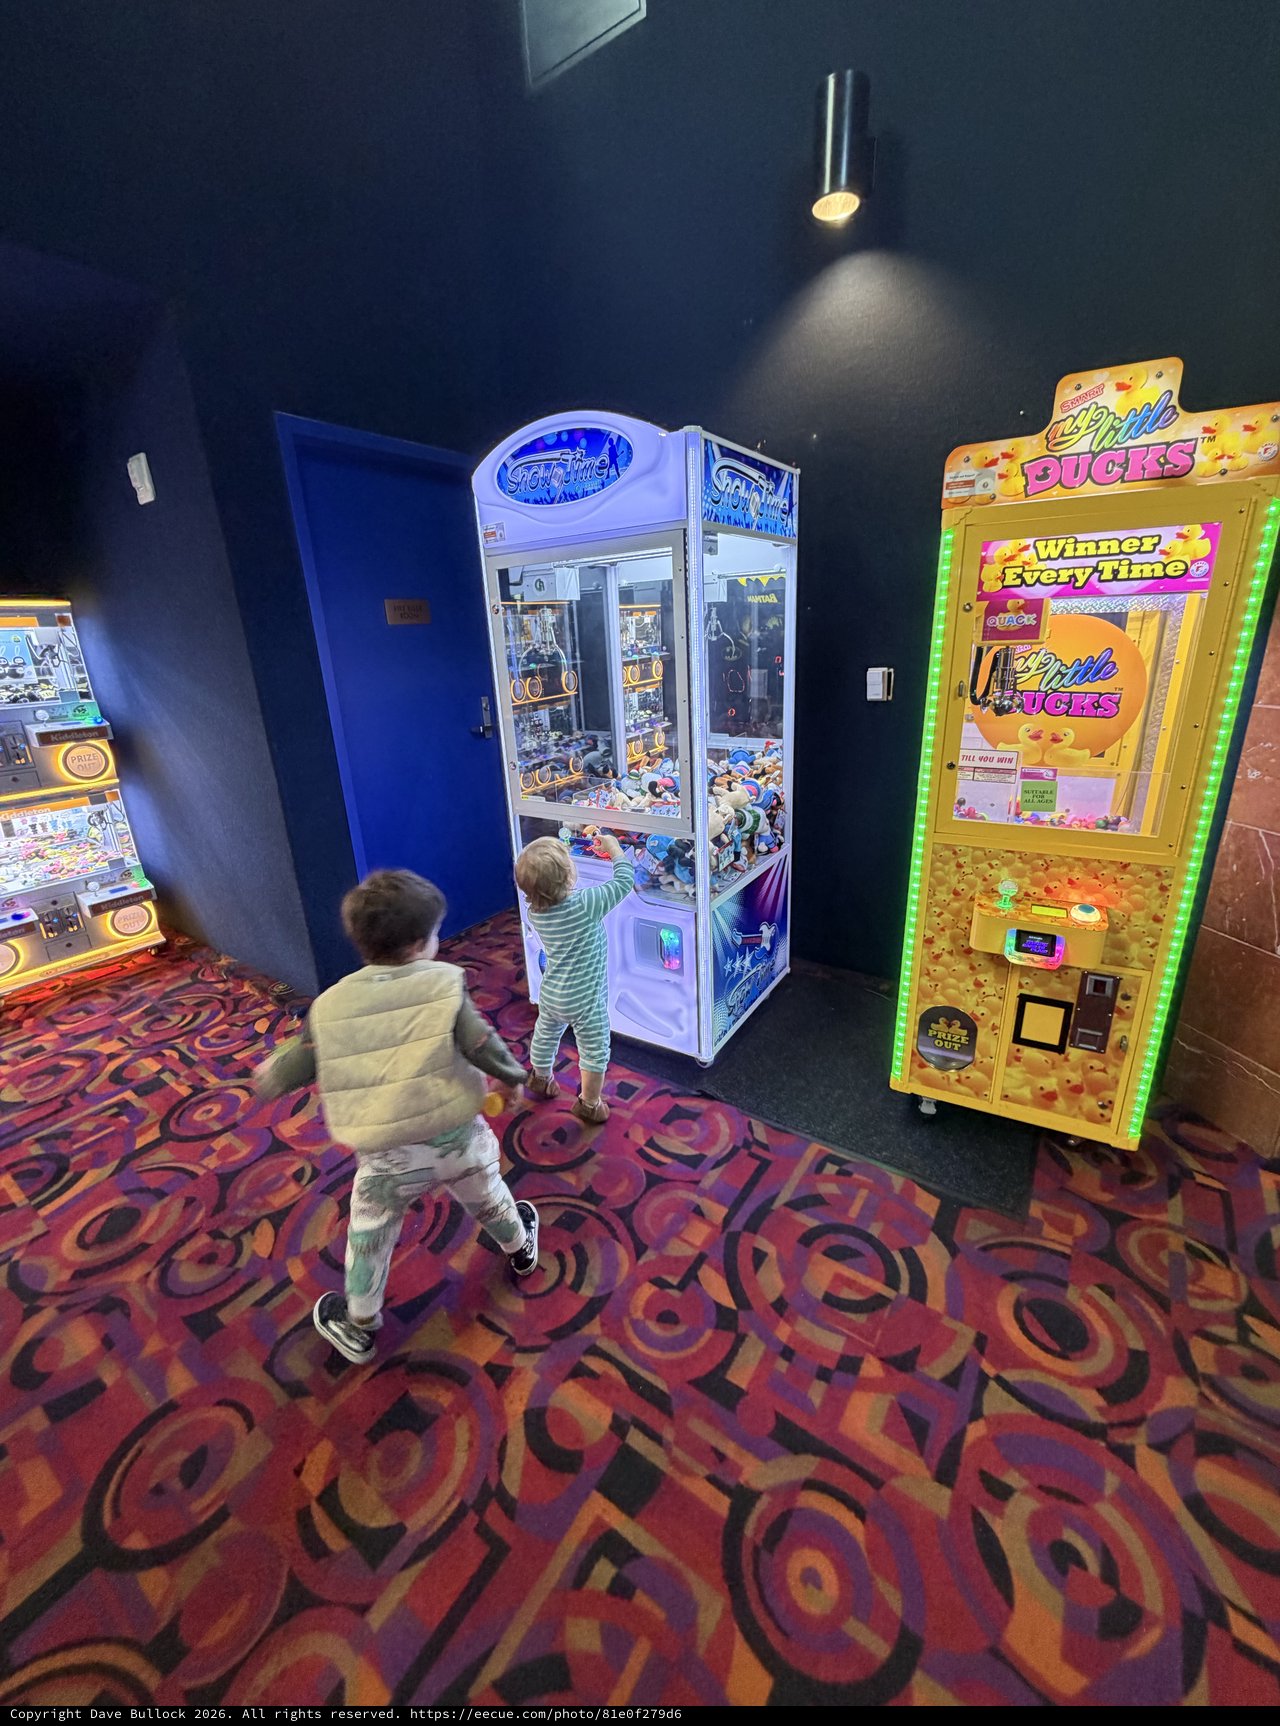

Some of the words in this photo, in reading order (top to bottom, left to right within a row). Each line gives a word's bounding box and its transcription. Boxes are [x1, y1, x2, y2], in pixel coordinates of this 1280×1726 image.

[1060, 383, 1105, 413] SMART
[1046, 401, 1109, 452] my
[1089, 389, 1180, 452] little
[1200, 435, 1217, 444] TM
[1024, 437, 1198, 497] DUCKS
[1033, 535, 1161, 561] Winner
[1002, 566, 1095, 589] Every
[1097, 558, 1189, 582] Time
[987, 613, 1037, 628] QUACK
[1040, 647, 1119, 692] little
[71, 754, 98, 764] PRIZE
[961, 754, 975, 762] TILL
[978, 755, 995, 763] YOU
[996, 756, 1014, 764] WIN
[928, 1028, 970, 1045] PRIZE
[934, 1039, 962, 1051] OUT
